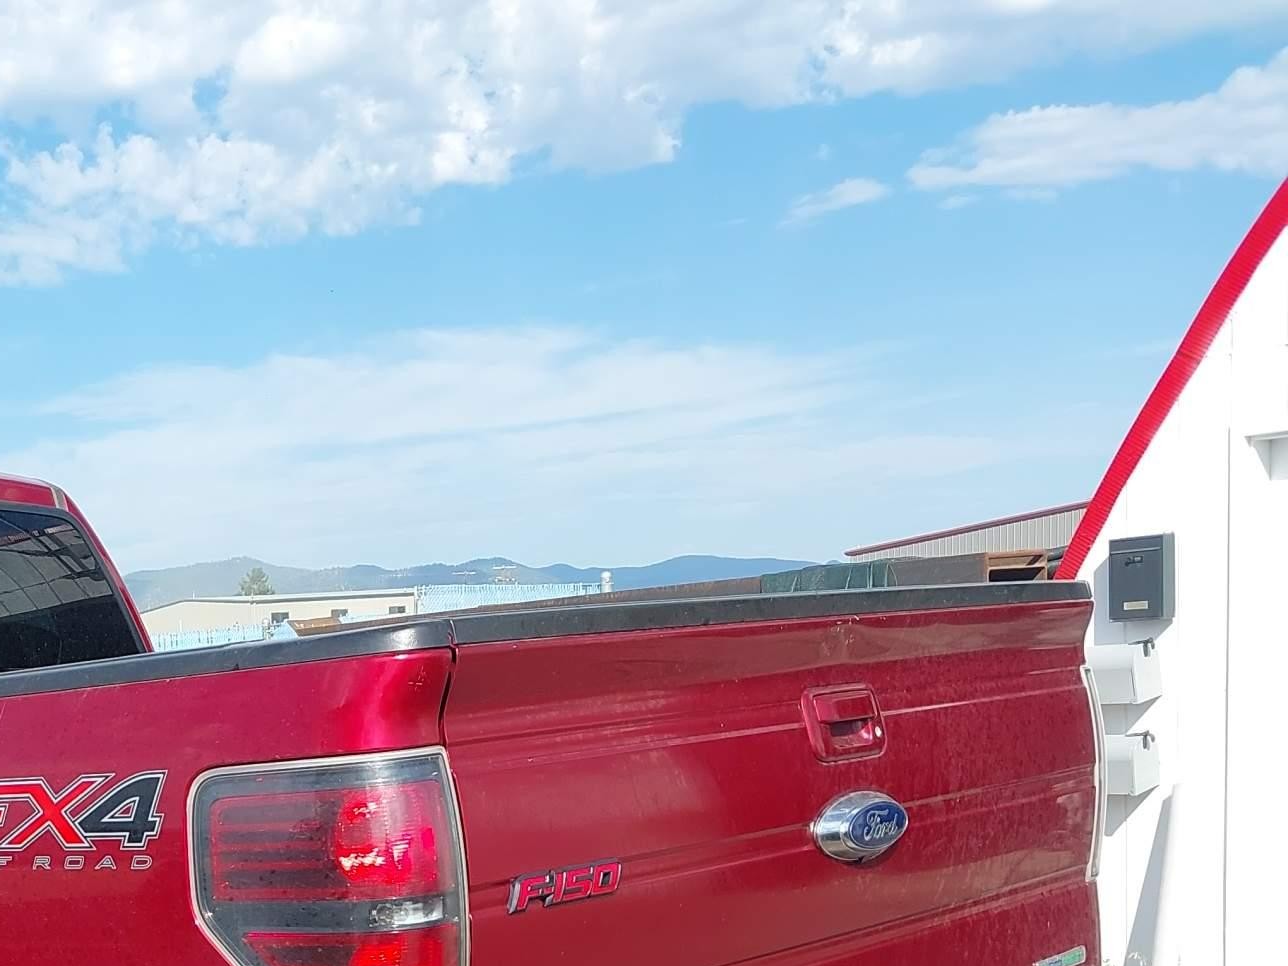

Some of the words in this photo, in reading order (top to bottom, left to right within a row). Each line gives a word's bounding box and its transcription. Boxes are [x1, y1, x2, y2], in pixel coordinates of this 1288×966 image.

[863, 808, 899, 841] Ford
[32, 856, 153, 871] ROAD
[506, 857, 623, 914] F-150
